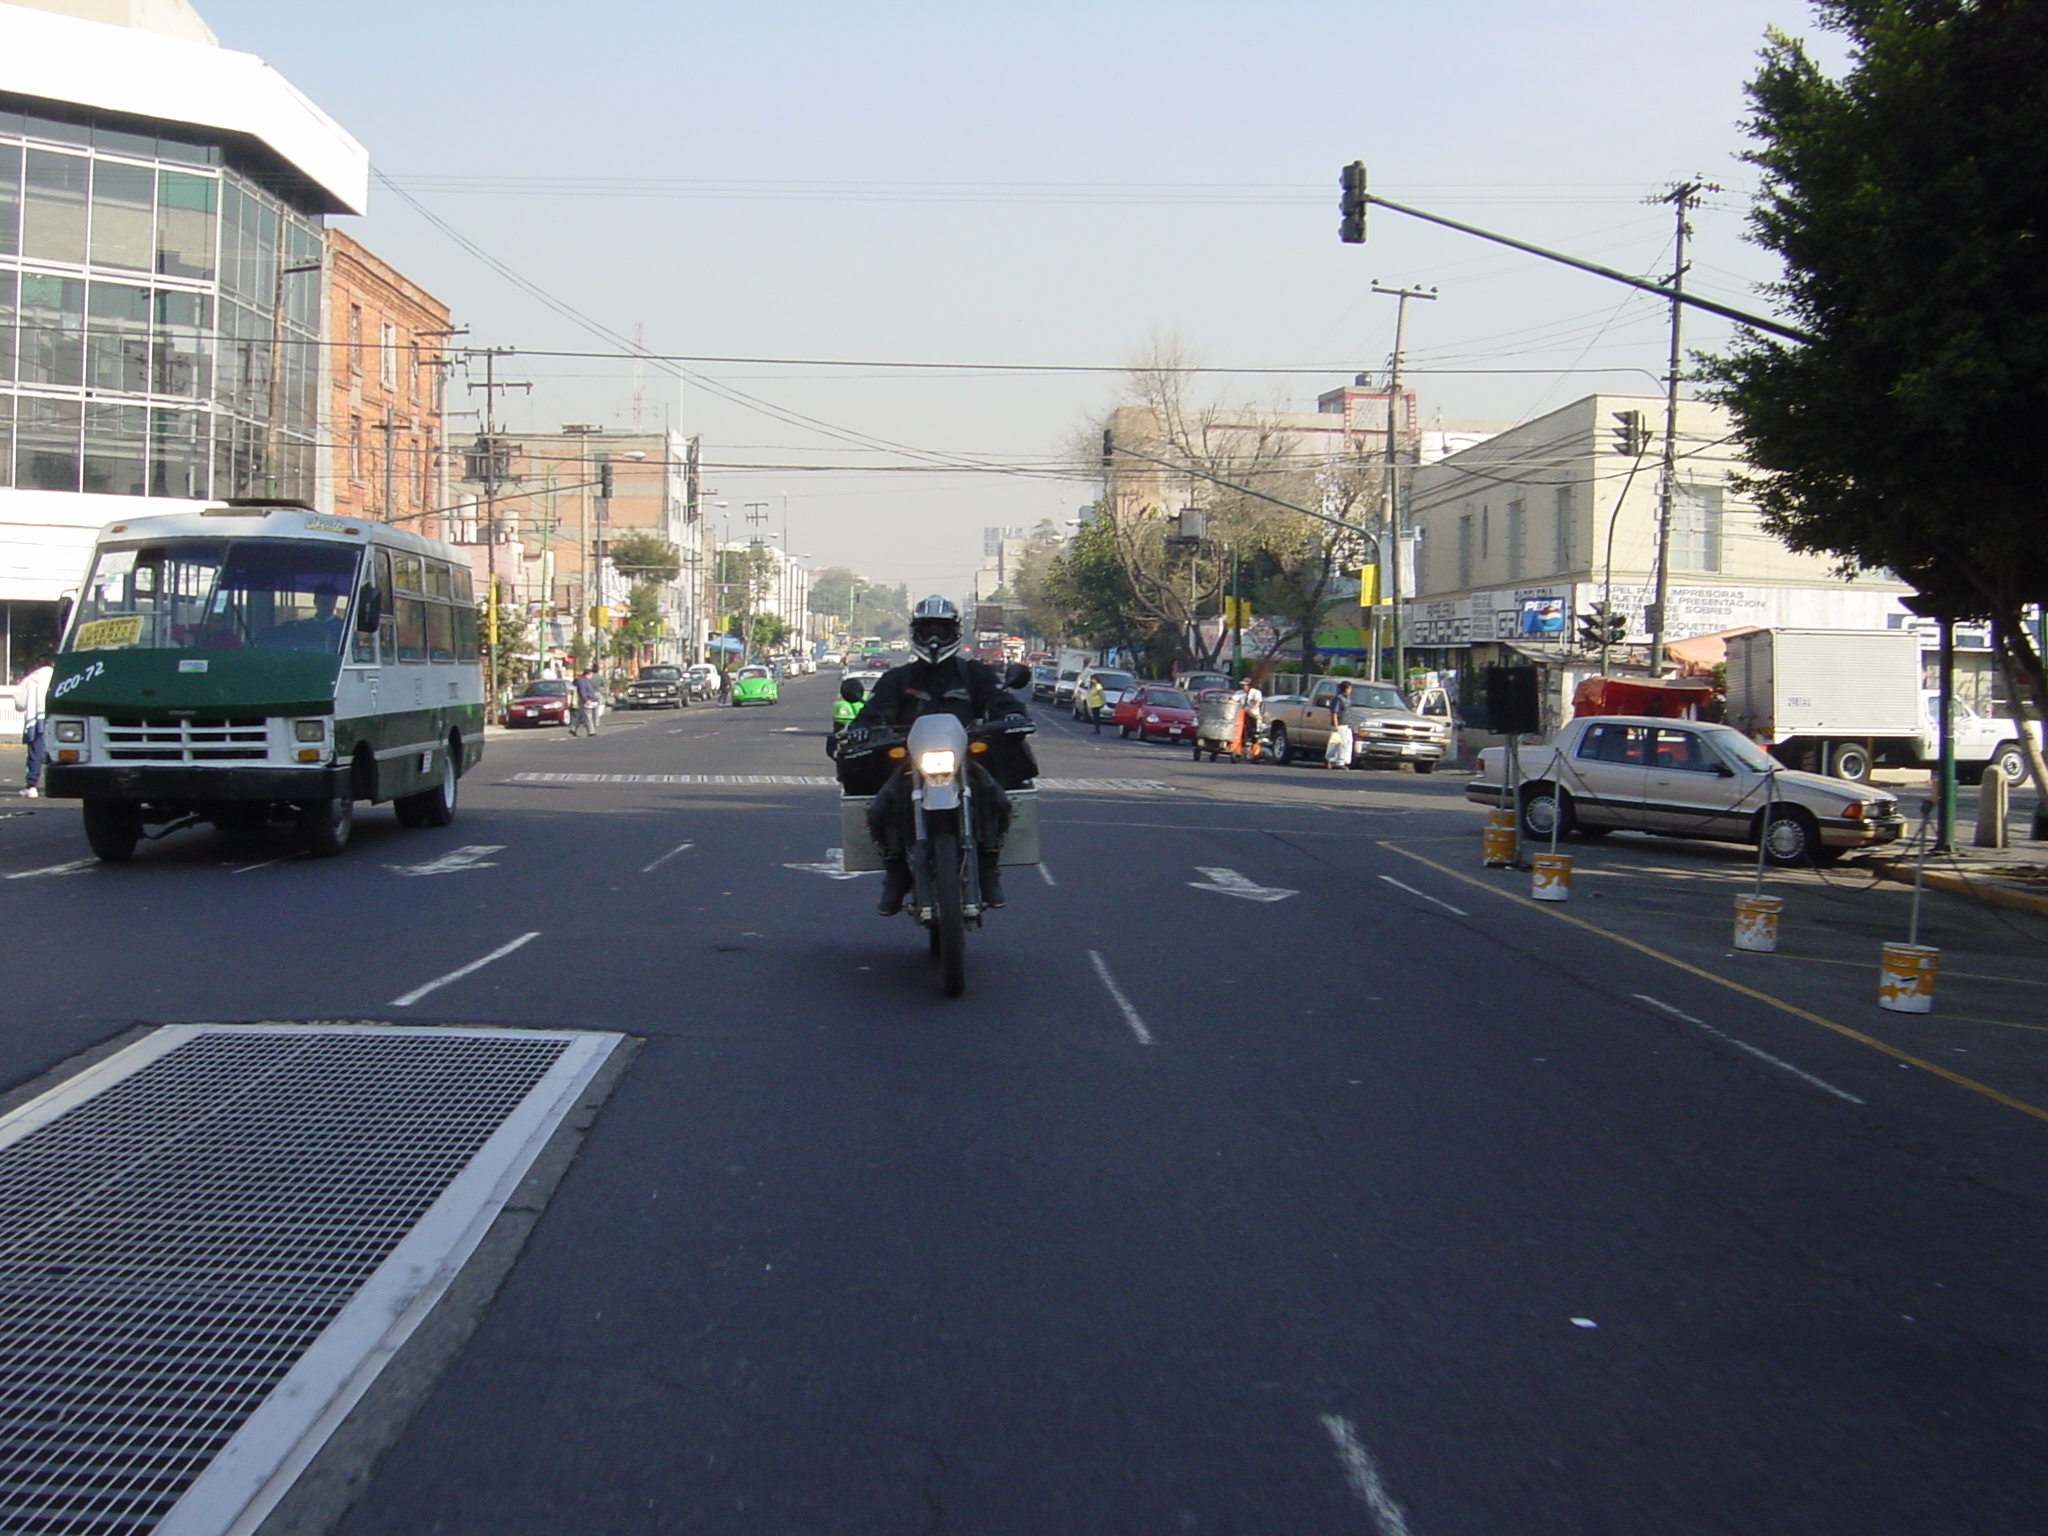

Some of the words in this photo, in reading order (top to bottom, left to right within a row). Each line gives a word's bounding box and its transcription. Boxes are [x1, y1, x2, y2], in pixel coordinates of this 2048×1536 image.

[1598, 585, 1634, 594] PPEL
[1671, 589, 1744, 599] IMPRESORAS
[1523, 599, 1562, 612] PEPSI
[1598, 594, 1652, 604] TRJETAS
[1678, 597, 1766, 608] PRESENTACION
[1685, 606, 1732, 615] SOBRES
[1665, 622, 1728, 632] ISQUETTES
[54, 661, 105, 698] ECO-72
